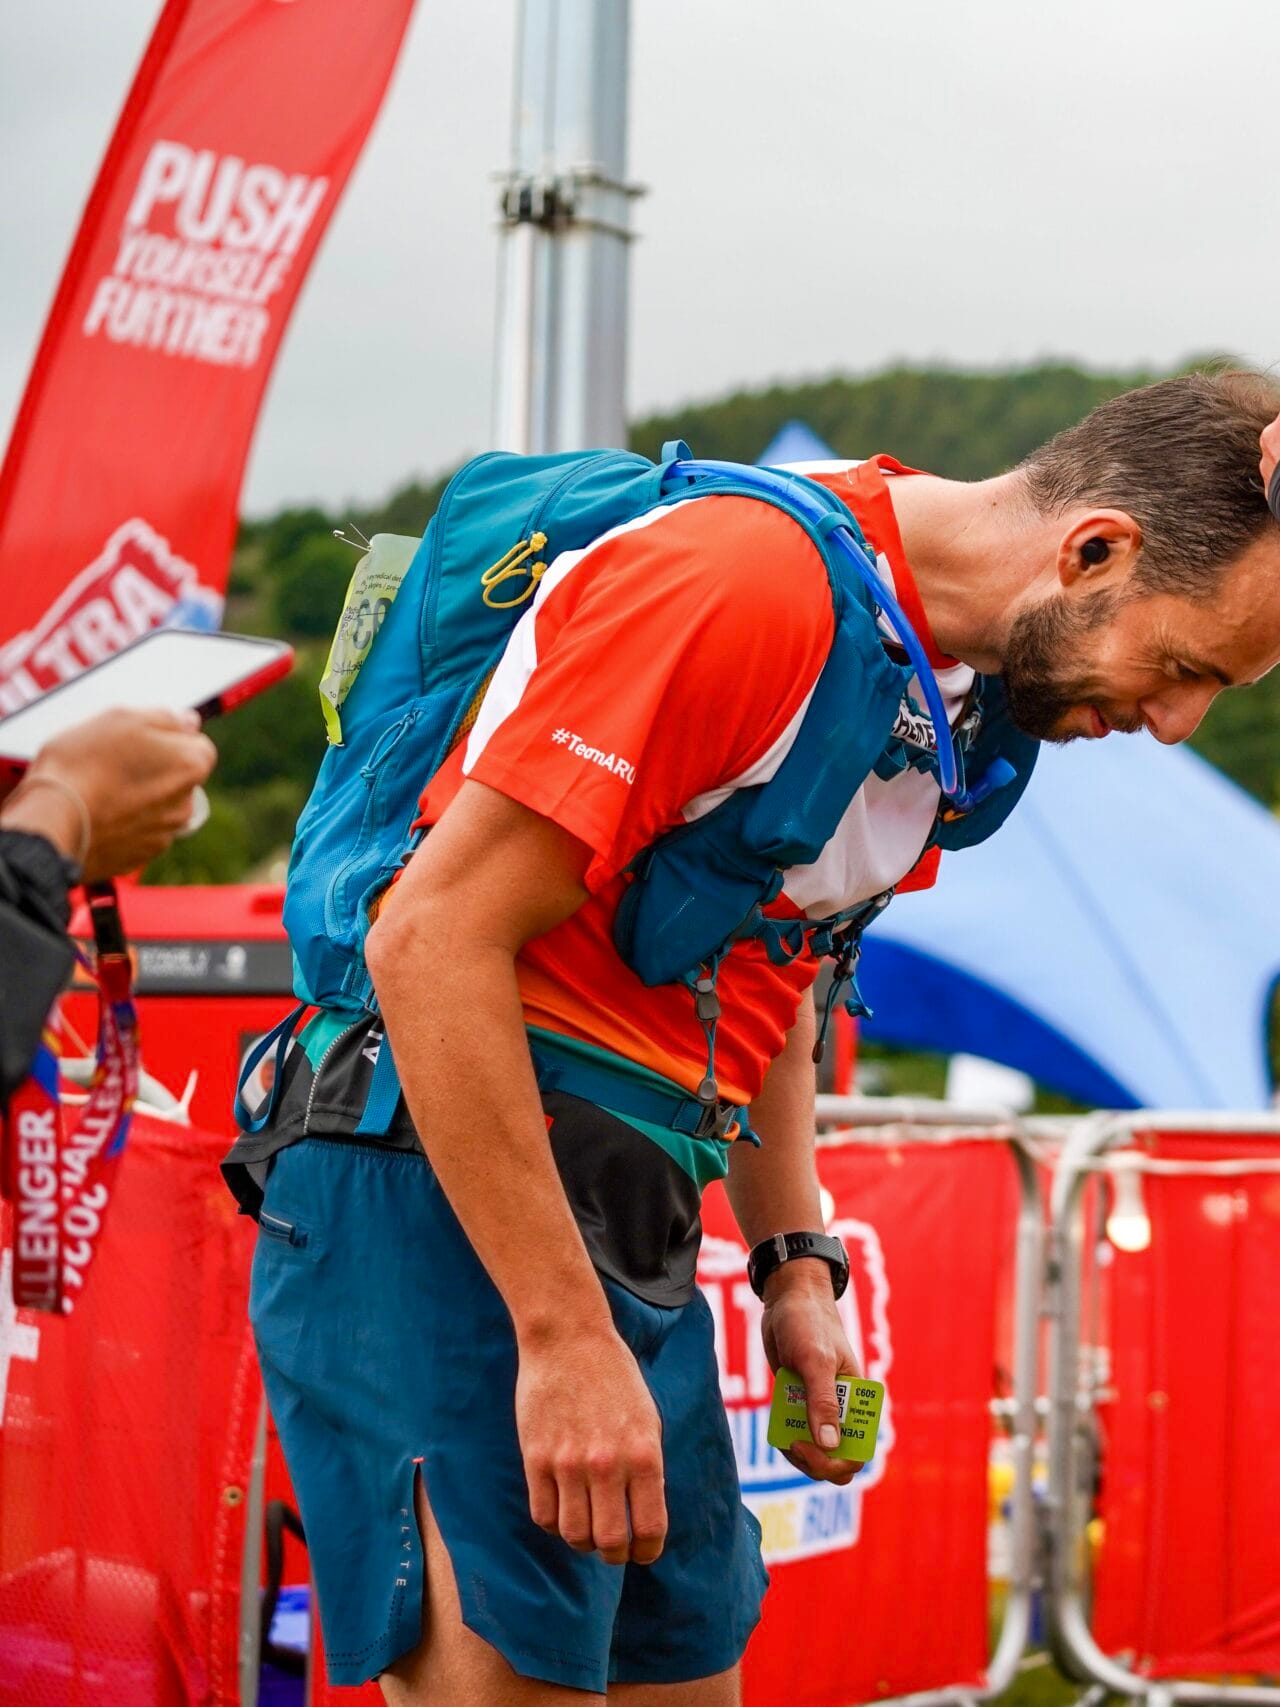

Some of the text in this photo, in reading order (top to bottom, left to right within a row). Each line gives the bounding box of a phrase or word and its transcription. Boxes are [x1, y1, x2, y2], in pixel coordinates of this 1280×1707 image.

[128, 139, 329, 254] PUSH
[114, 231, 292, 302] YOURSELF
[83, 276, 269, 368] FURTHER
[19, 1110, 57, 1309] LLENGER
[785, 1418, 806, 1429] 2026
[855, 1387, 876, 1398] 5093
[395, 1507, 412, 1587] FLYTE
